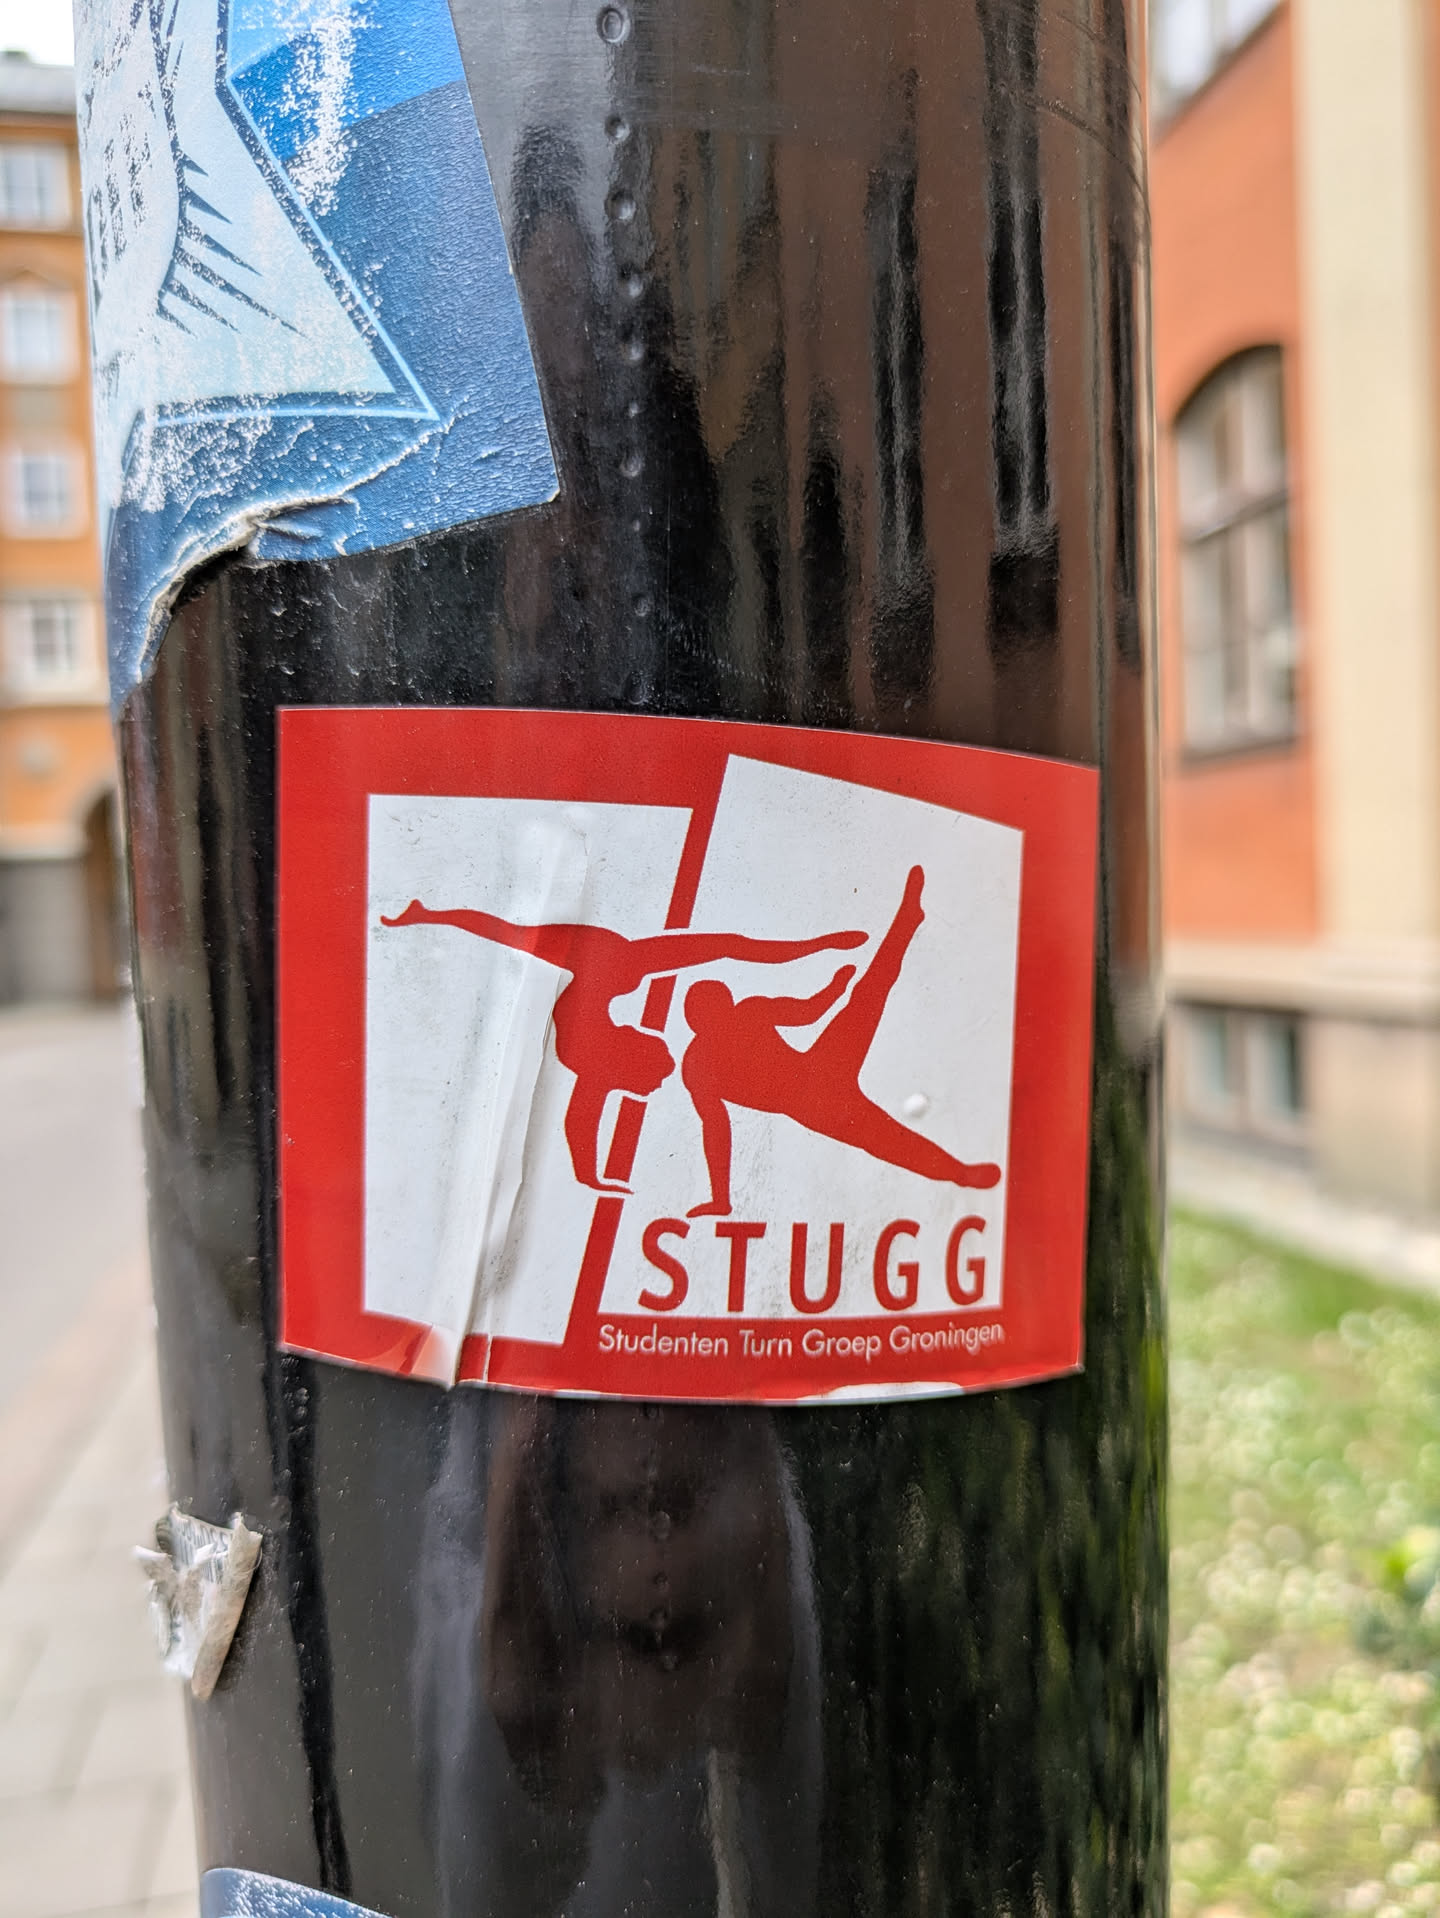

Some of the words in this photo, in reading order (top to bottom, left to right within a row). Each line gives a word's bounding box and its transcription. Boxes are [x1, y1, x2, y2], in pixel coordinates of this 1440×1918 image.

[638, 1216, 986, 1314] STUGG
[598, 1324, 728, 1356] Studenten
[741, 1330, 793, 1357] Turn
[802, 1329, 881, 1362] Groep
[889, 1322, 1004, 1355] Groningen
